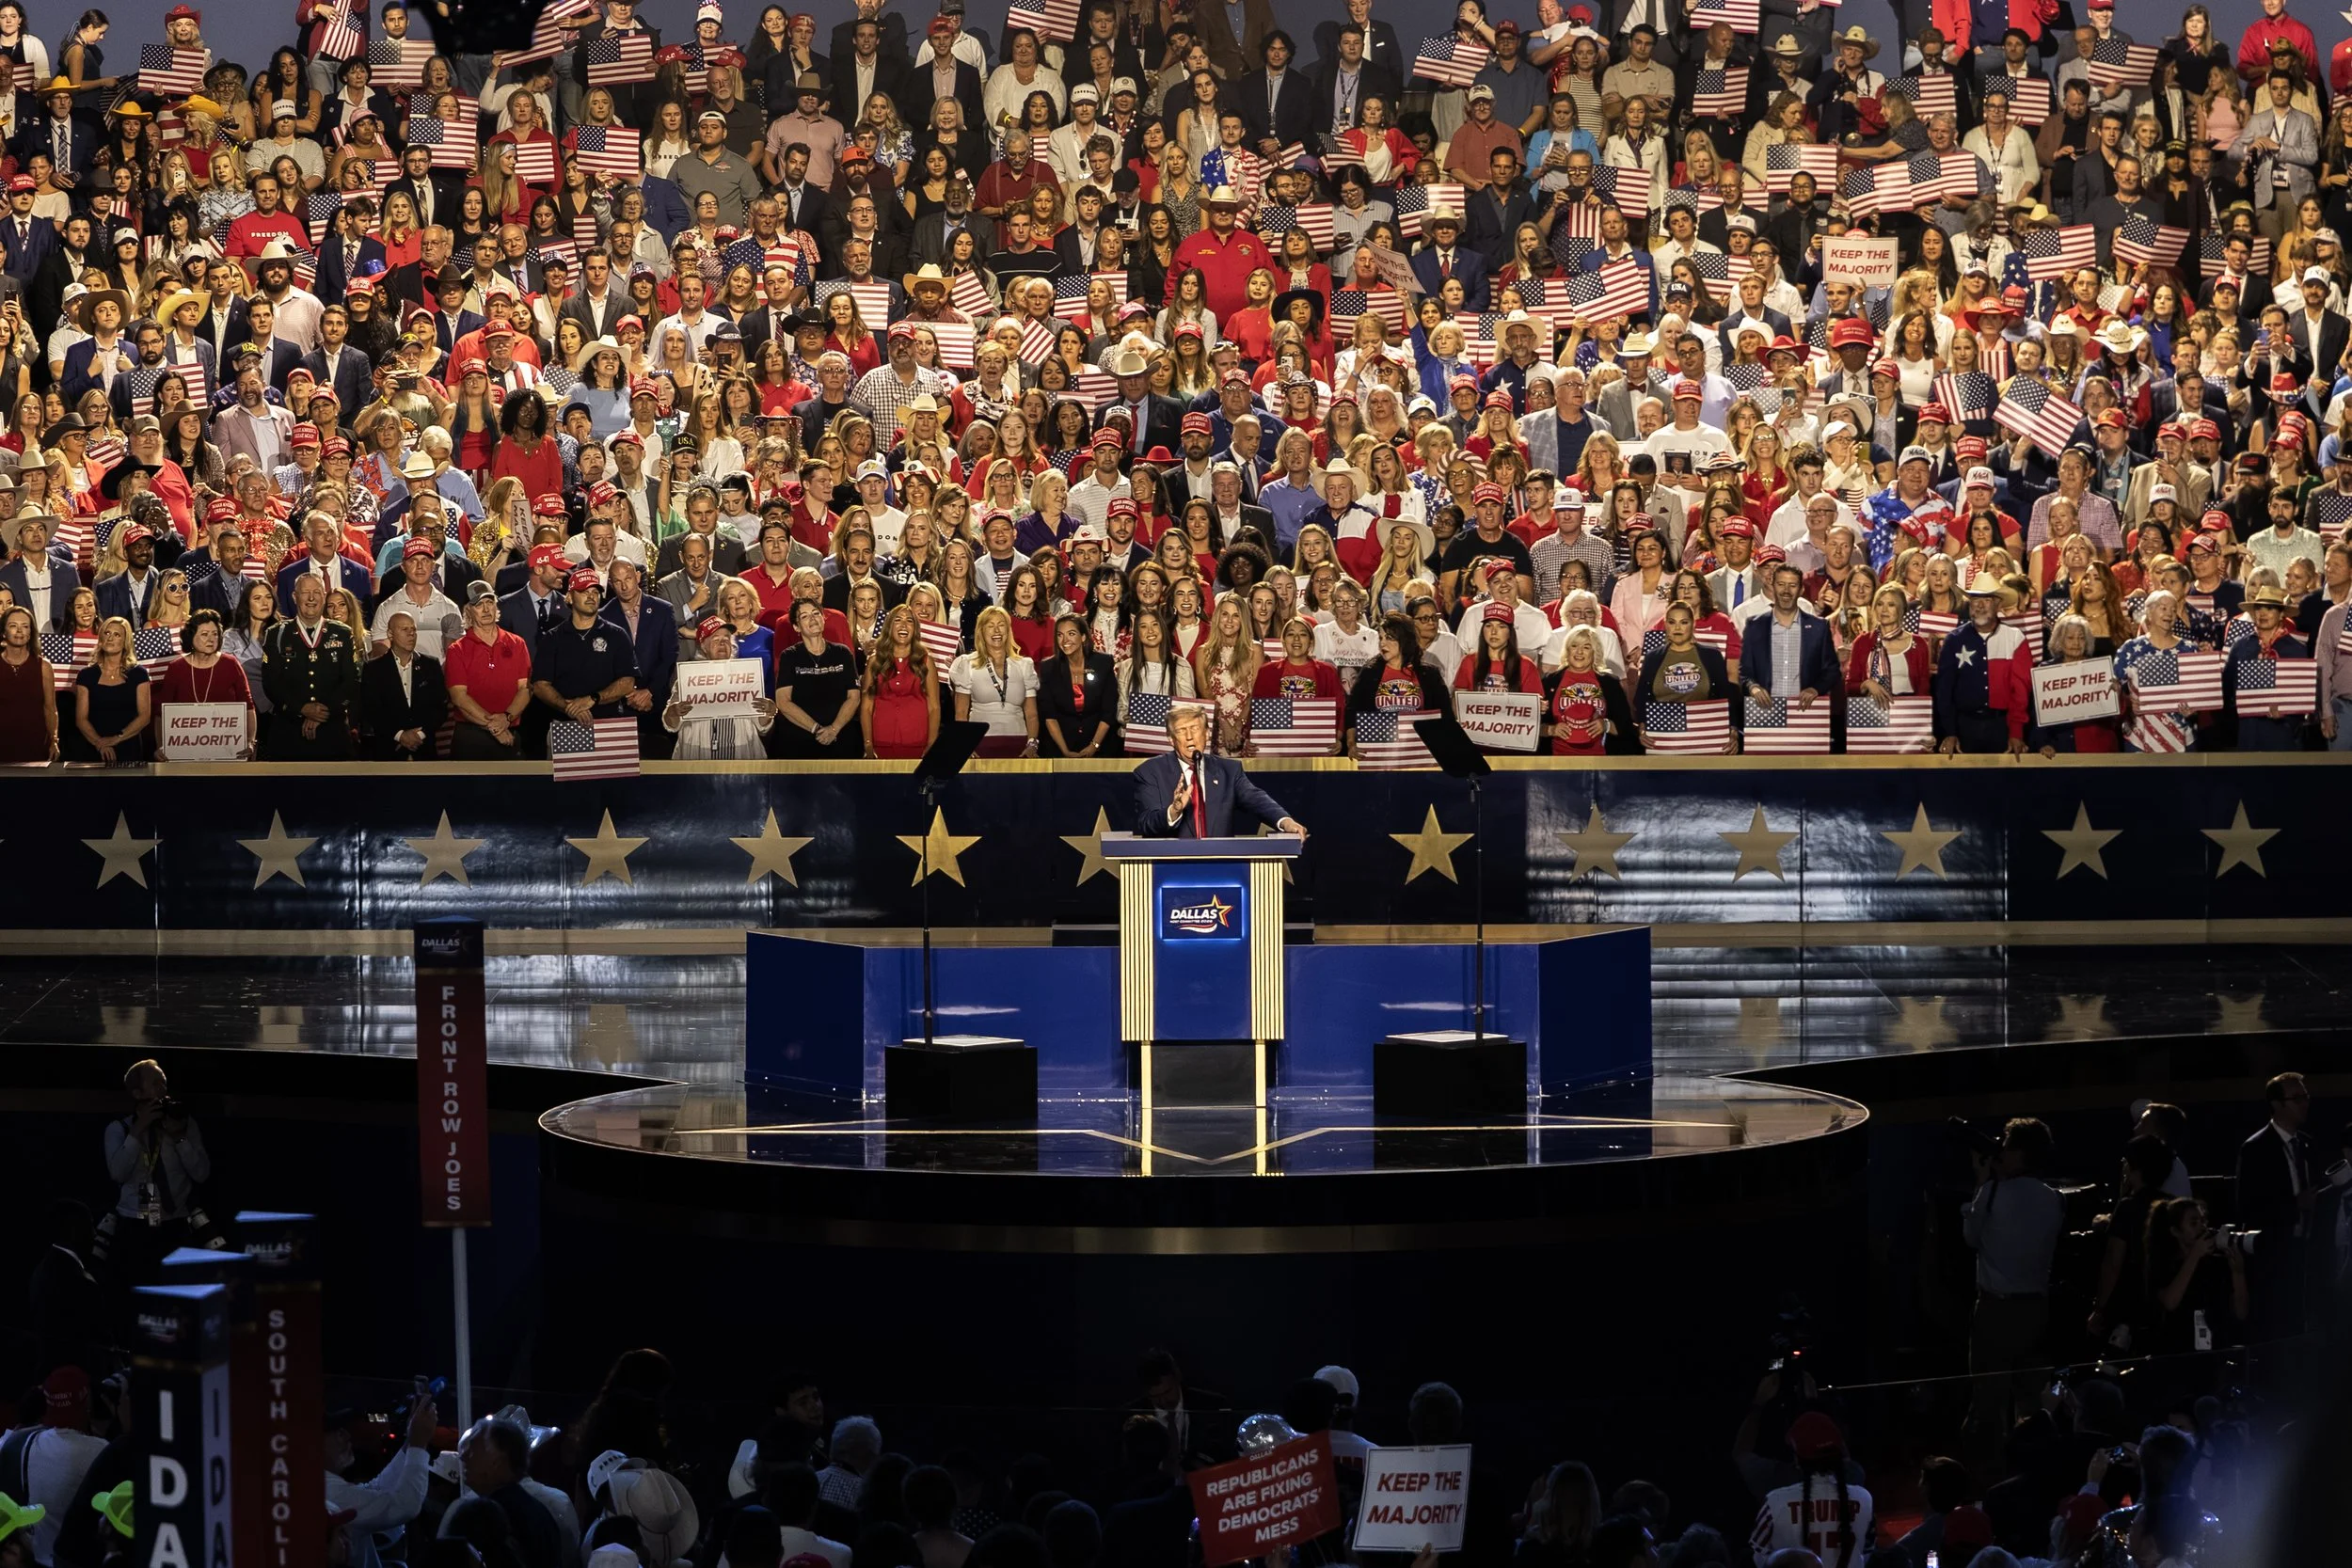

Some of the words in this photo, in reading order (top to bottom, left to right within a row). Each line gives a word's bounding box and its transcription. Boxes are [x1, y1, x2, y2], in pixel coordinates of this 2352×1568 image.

[1830, 248, 1863, 260] KEEP
[1867, 248, 1890, 260] THE
[1828, 262, 1893, 275] MAJORITY
[1670, 283, 1687, 292] USA
[688, 674, 723, 687] KEEP
[728, 673, 755, 684] THE
[1665, 673, 1700, 684] UNITED
[2042, 676, 2077, 692] KEEP
[2080, 672, 2106, 685] THE
[686, 689, 759, 705] MAJORITY
[1376, 696, 1420, 707] UNITED
[2042, 689, 2110, 710] MAJORITY
[1466, 705, 1502, 715] KEEP
[1505, 705, 1532, 717] THE
[170, 717, 207, 729] KEEP
[211, 717, 238, 728] THE
[1462, 721, 1534, 736] MAJORITY
[167, 735, 242, 746] MAJORITY
[1170, 909, 1217, 920] DALLAS
[421, 939, 460, 947] DALLAS
[441, 985, 458, 1074] FRONT
[441, 1082, 462, 1133] ROW
[445, 1141, 461, 1211] JOES
[245, 1242, 293, 1254] DALLAS
[268, 1308, 288, 1420] SOUTH
[149, 1388, 189, 1568] IDA
[1205, 1449, 1319, 1498] REPUBLICANS
[1376, 1473, 1430, 1493] KEEP
[1435, 1471, 1462, 1492] THE
[270, 1434, 291, 1567] CAROLI
[1222, 1488, 1259, 1513] ARE
[1261, 1472, 1313, 1503] FIXING
[1366, 1503, 1462, 1526] MAJORITY
[1254, 1516, 1300, 1544] MESS
